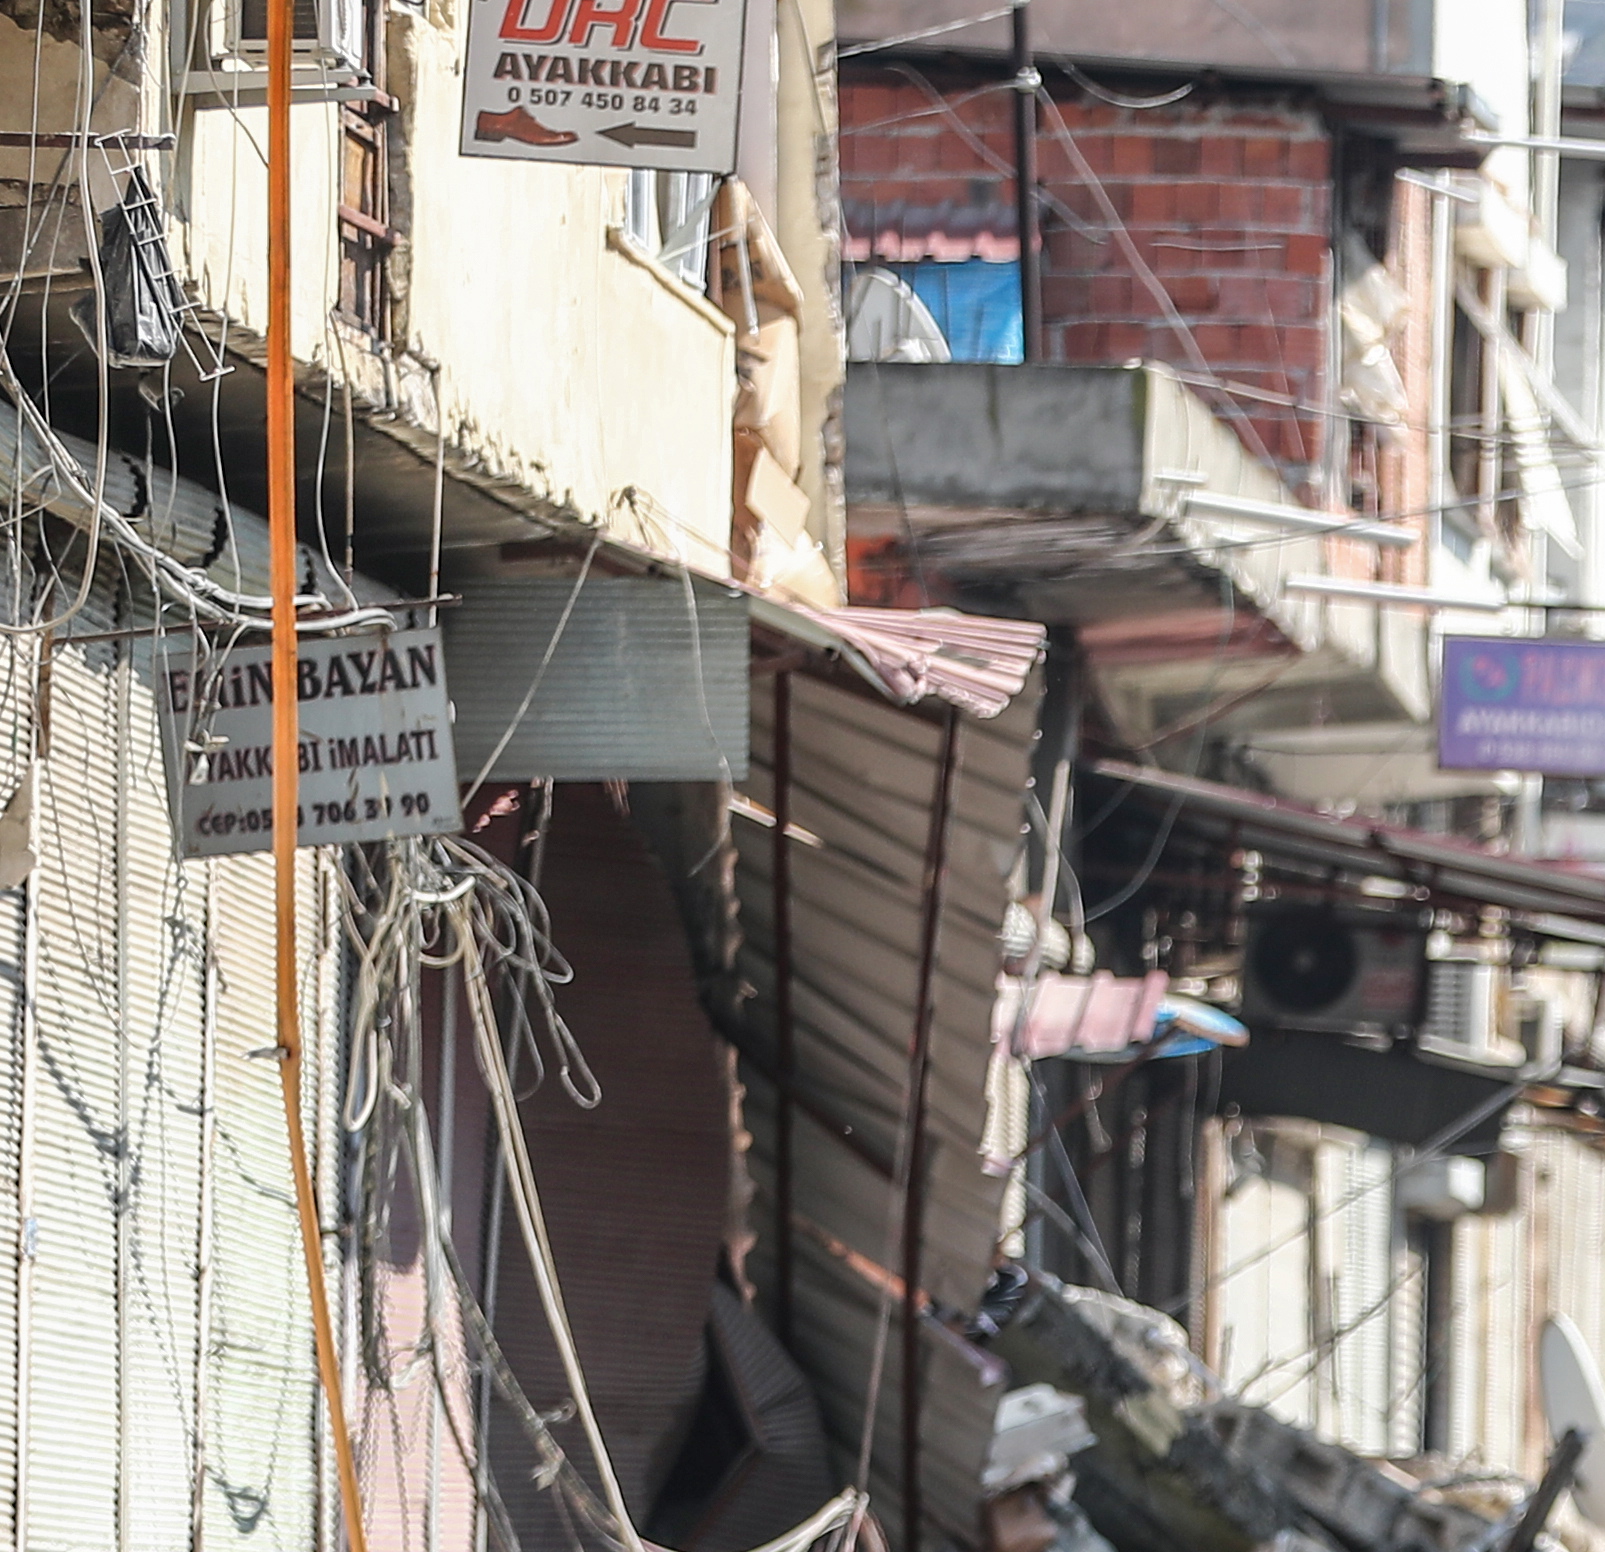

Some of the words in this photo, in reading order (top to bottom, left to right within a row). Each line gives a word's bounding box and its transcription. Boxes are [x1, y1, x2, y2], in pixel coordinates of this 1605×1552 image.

[493, 52, 718, 94] AYAKKABI
[508, 87, 520, 103] 0
[530, 88, 572, 107] 507
[581, 92, 624, 111] 450
[633, 96, 660, 114] 84
[669, 98, 698, 115] 34
[297, 645, 437, 702] BAYAN
[313, 800, 356, 825] 706
[401, 793, 430, 817] 90
